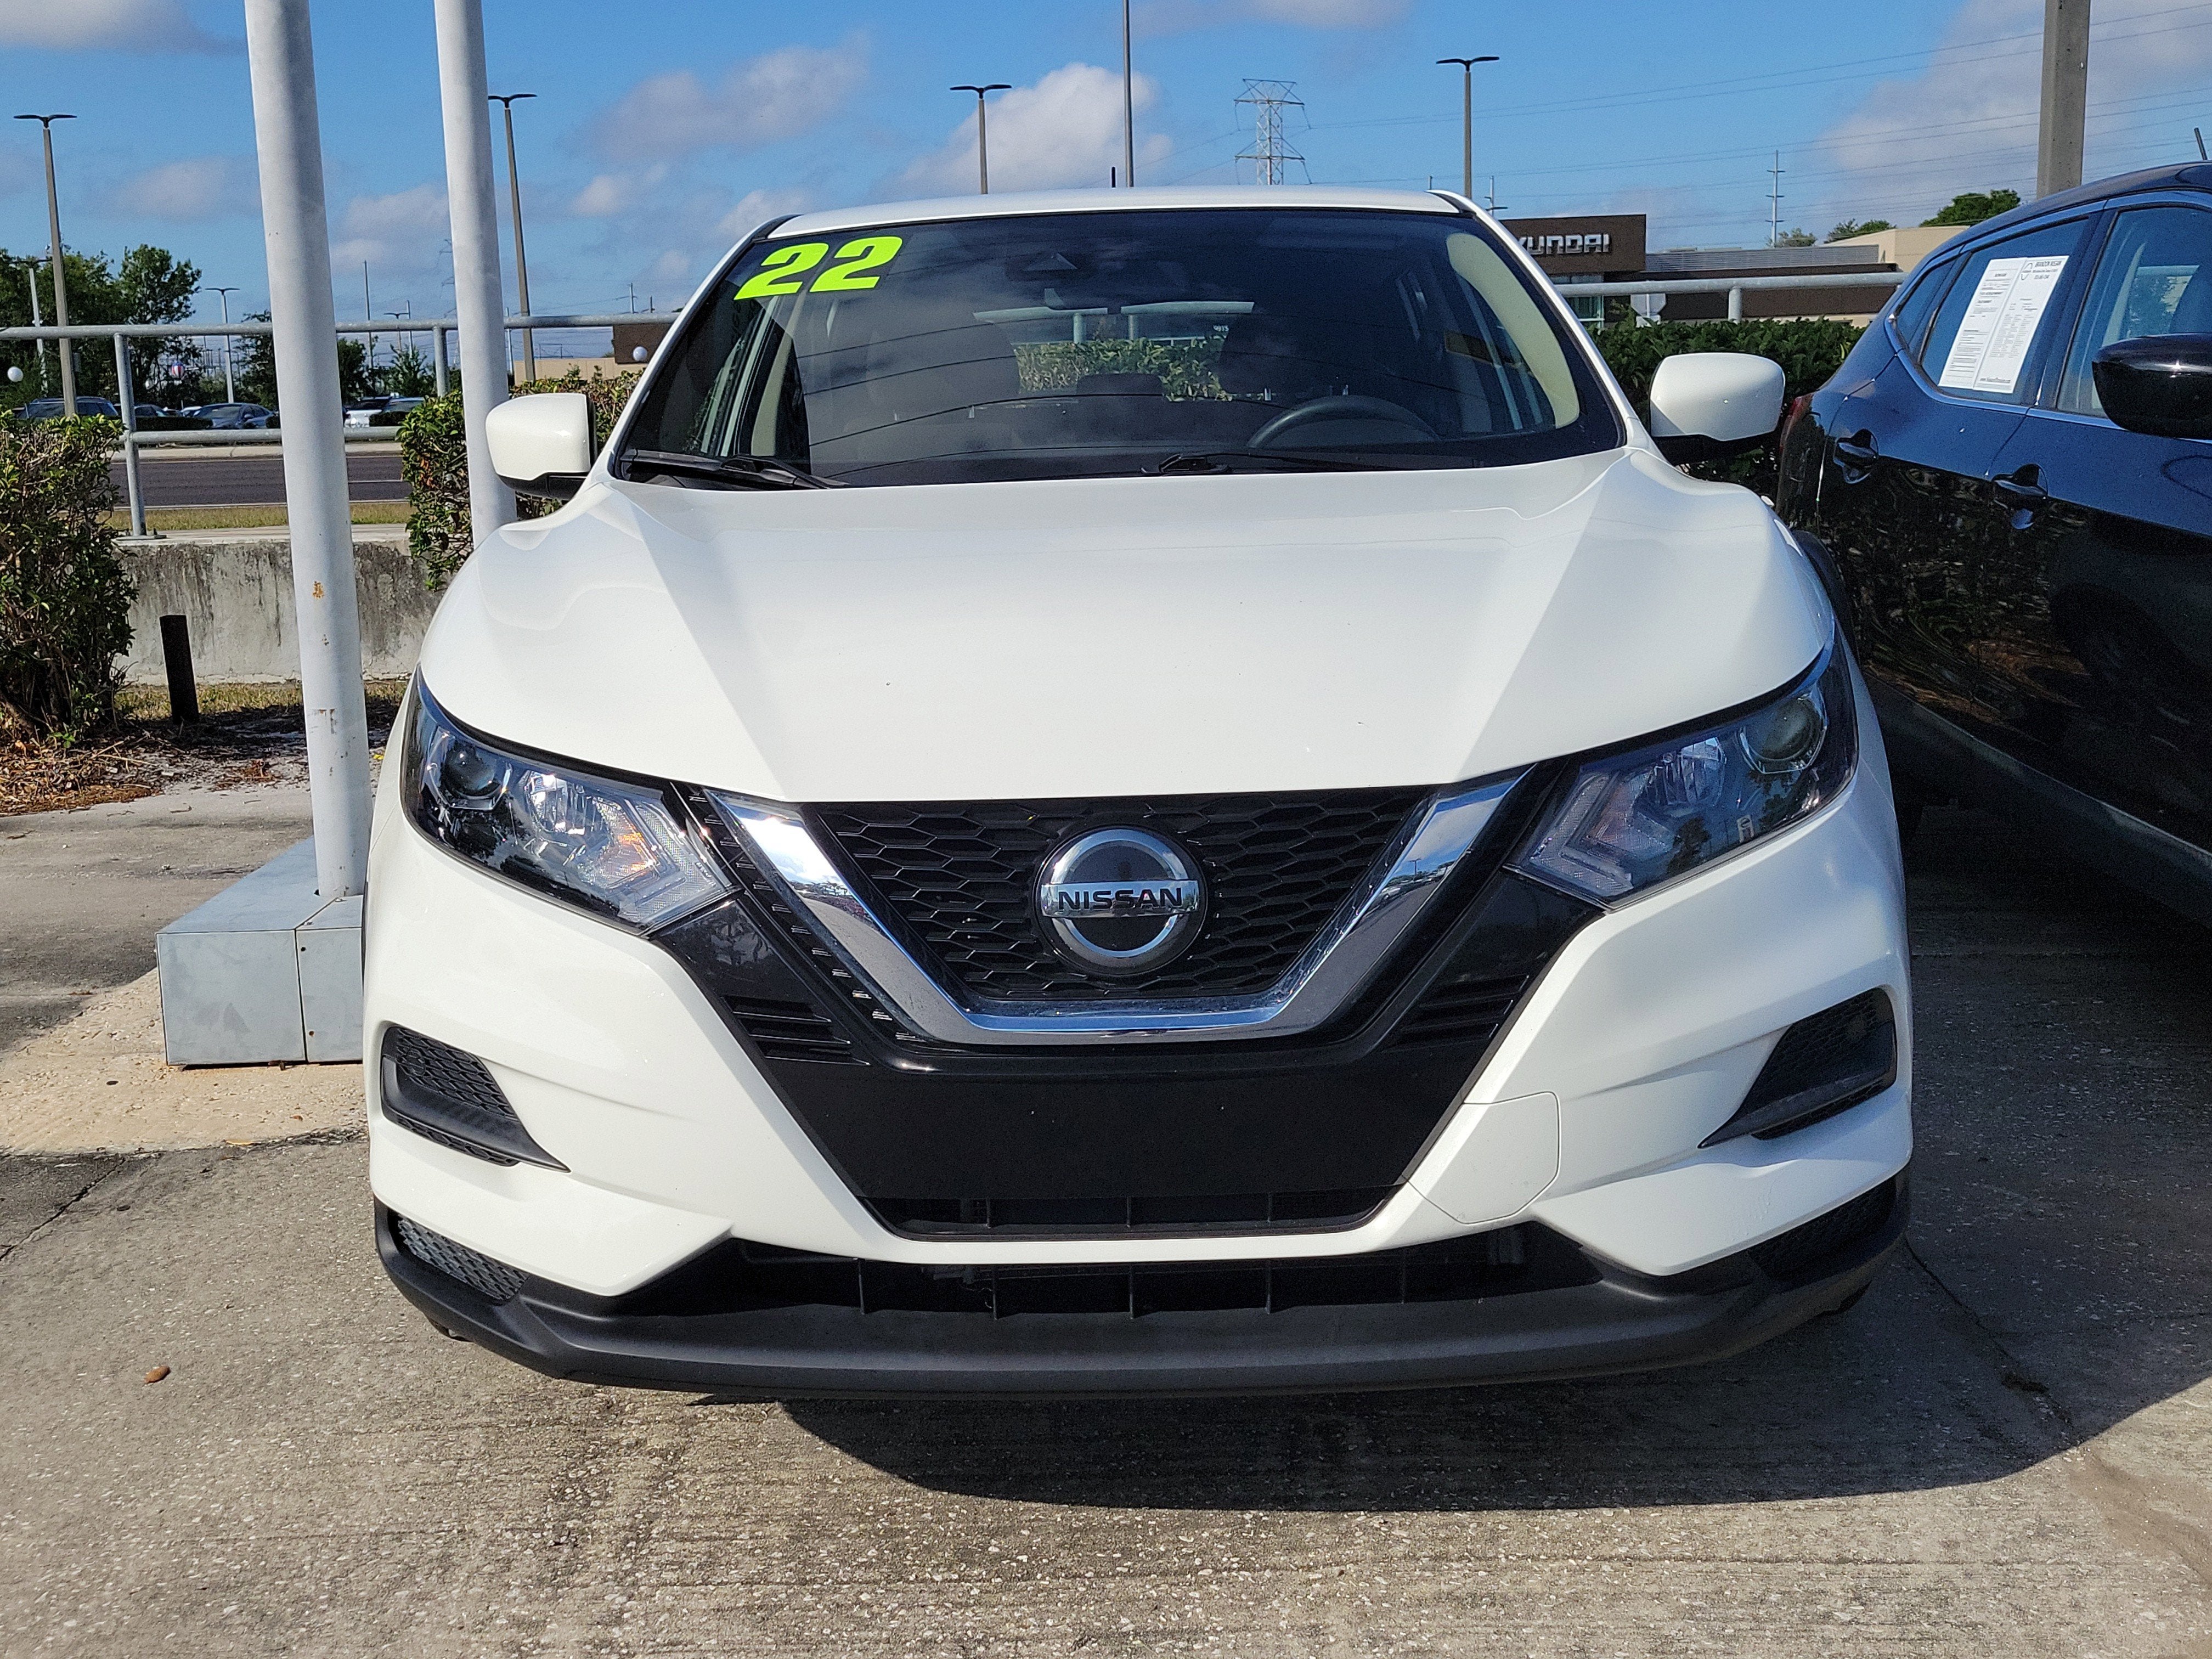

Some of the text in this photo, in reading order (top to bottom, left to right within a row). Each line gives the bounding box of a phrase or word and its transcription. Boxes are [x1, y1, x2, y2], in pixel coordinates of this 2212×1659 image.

[1519, 234, 1611, 255] UNDAI
[736, 238, 901, 299] 22
[1058, 887, 1182, 910] NISSAN
